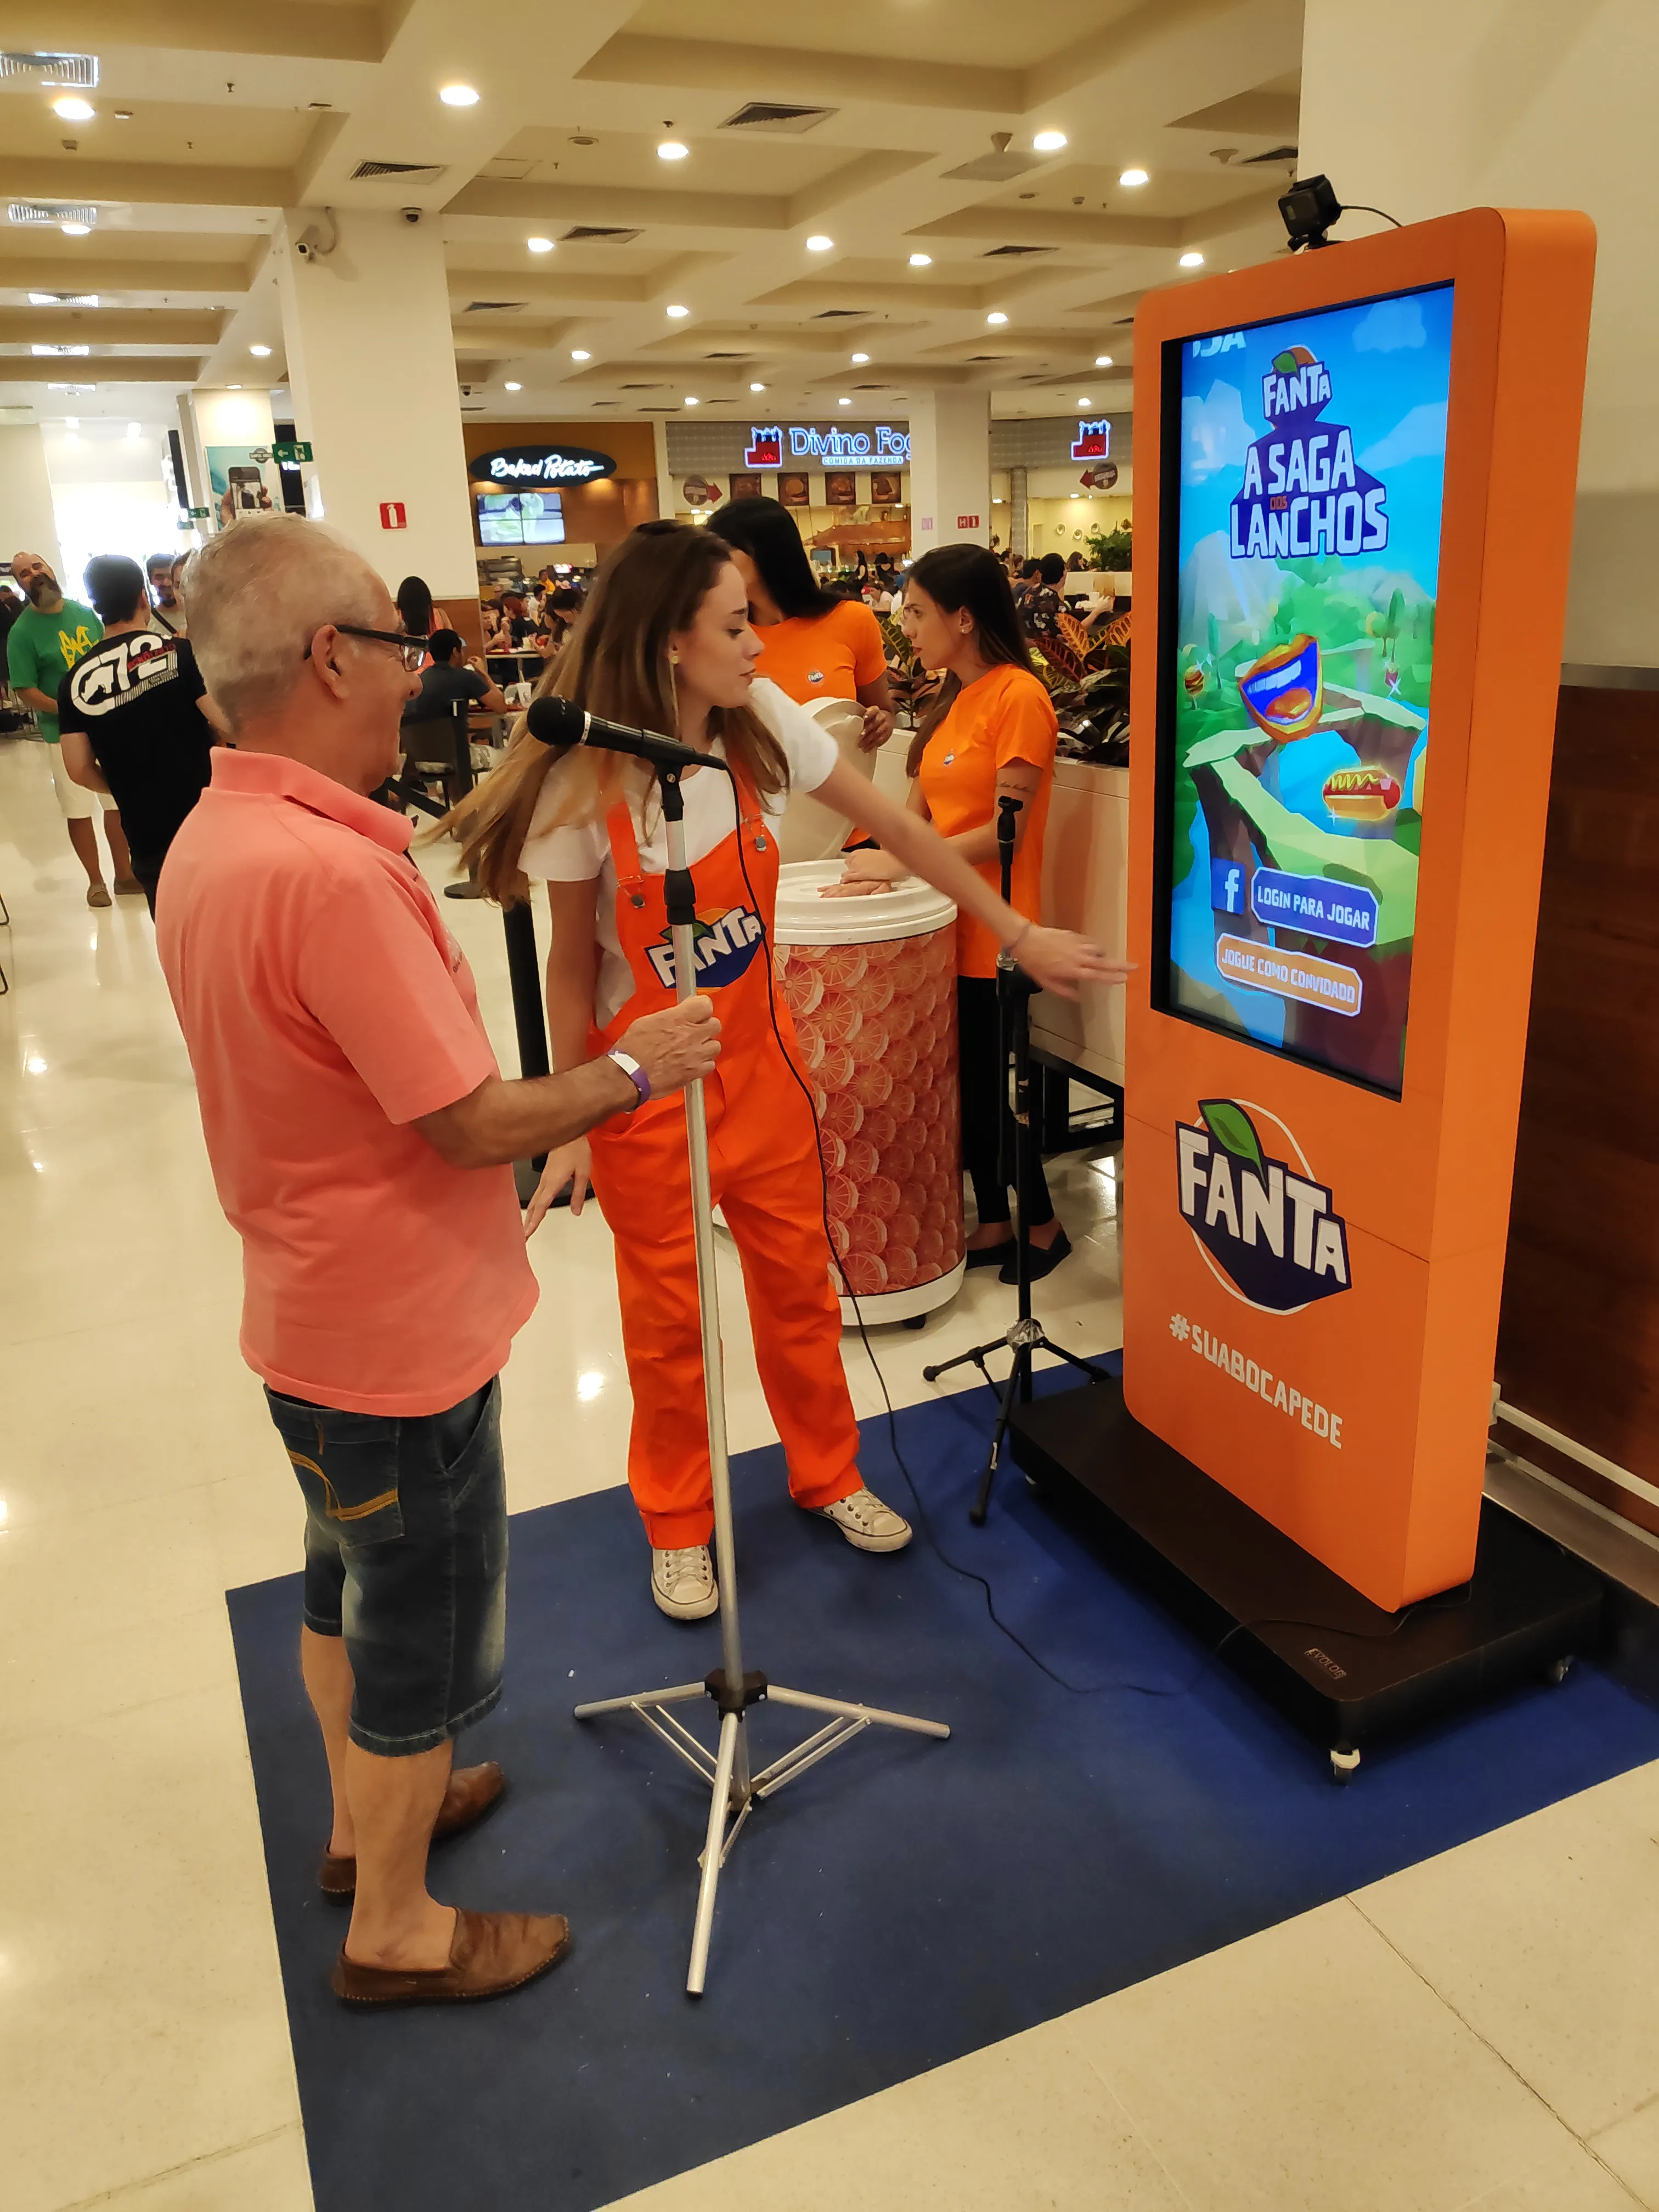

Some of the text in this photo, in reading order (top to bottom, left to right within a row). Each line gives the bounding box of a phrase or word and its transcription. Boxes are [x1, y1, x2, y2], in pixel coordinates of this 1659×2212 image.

[1263, 363, 1331, 417] FANTA
[490, 454, 605, 479] Baked Potato
[788, 426, 870, 456] Divino
[1243, 428, 1356, 500] A SAGA
[1231, 487, 1387, 557] LANCHOS
[1269, 495, 1288, 510] DOS
[1257, 885, 1370, 931] LOGIN PARA JOGAR
[1221, 948, 1356, 1004] JOGUE COMO CONVIDADO
[1178, 1127, 1347, 1285] FANTA
[1169, 1312, 1344, 1449] #SUABOCAPEDE
